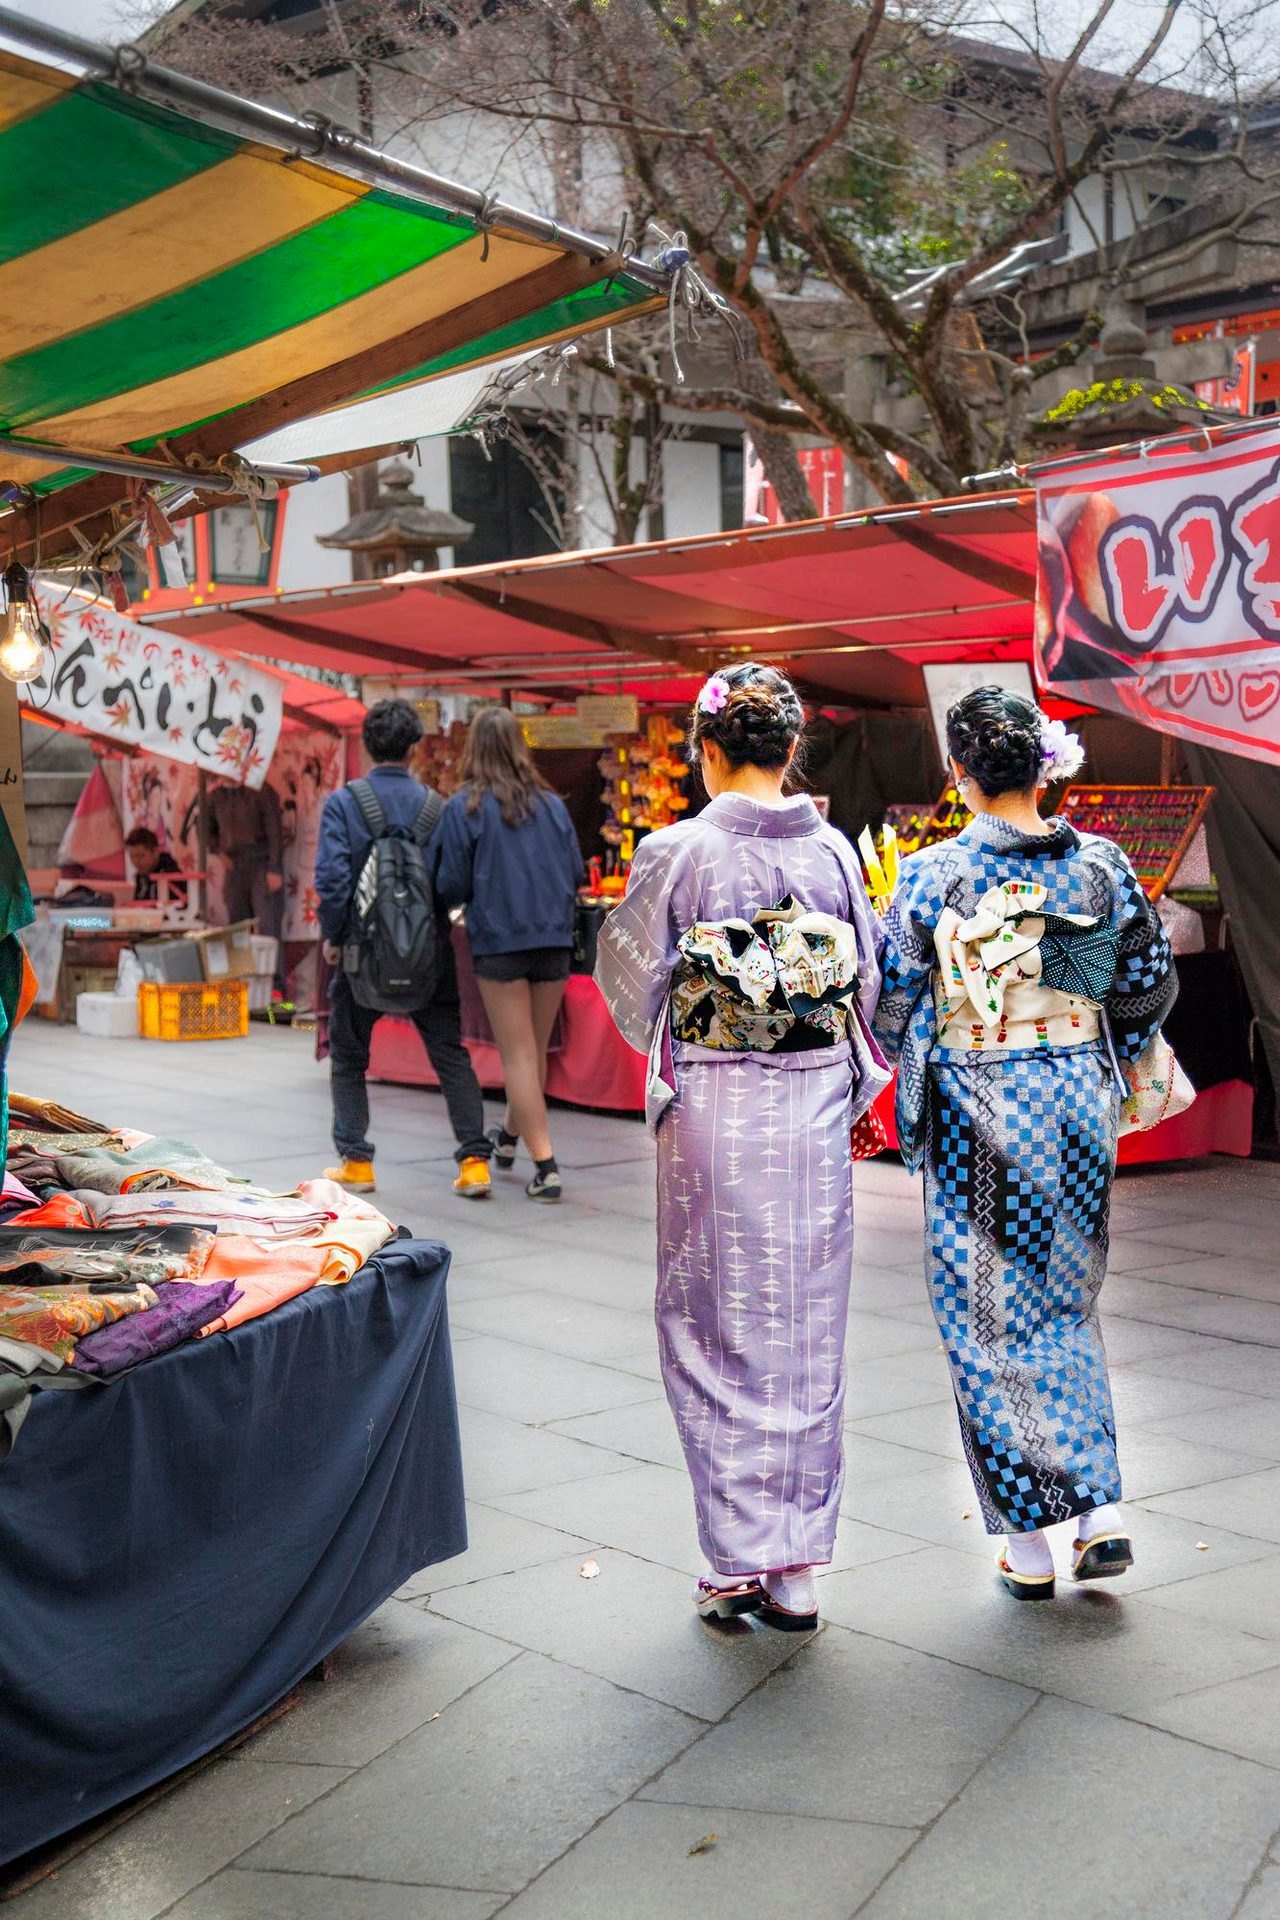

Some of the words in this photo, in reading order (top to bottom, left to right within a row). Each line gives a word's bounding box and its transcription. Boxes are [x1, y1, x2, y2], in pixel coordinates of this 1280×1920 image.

[31, 637, 265, 757] んぺいとう
